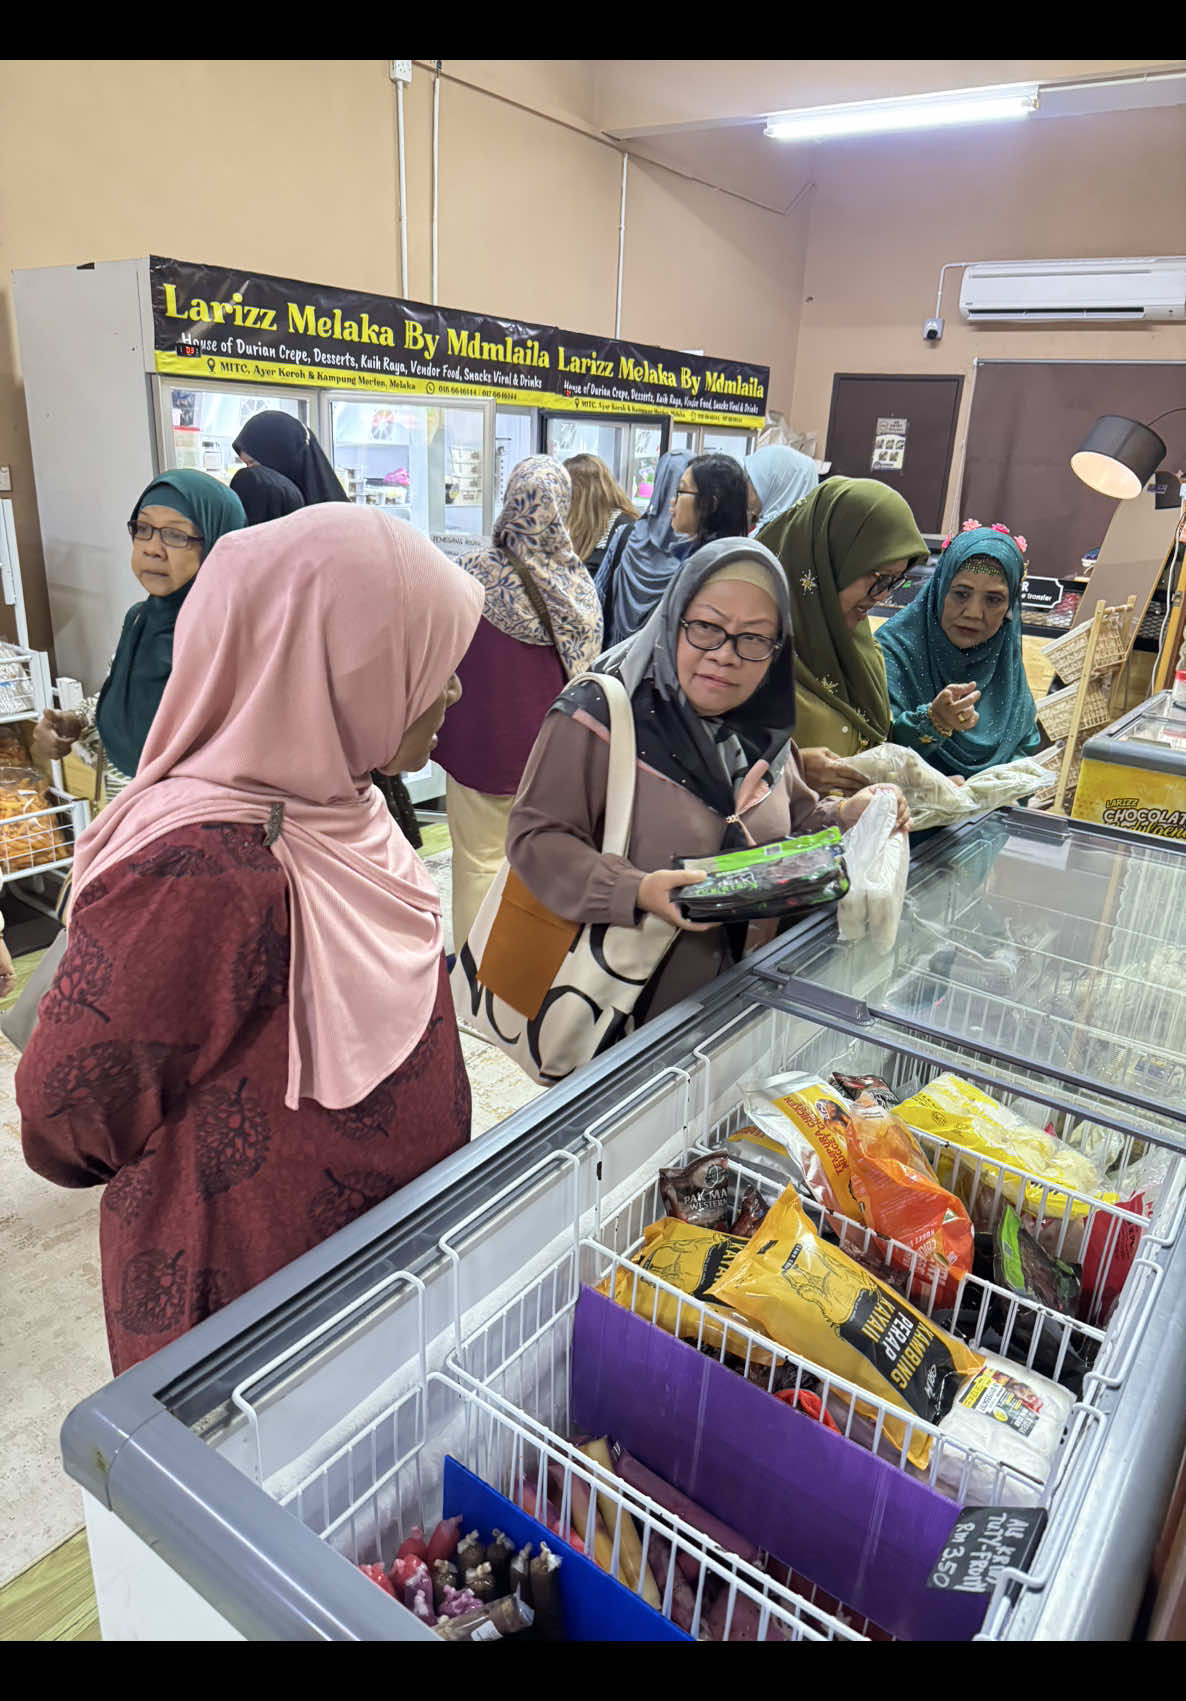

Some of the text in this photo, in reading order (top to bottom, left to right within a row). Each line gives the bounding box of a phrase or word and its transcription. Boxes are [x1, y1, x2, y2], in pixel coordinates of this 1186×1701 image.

[163, 283, 550, 369] Larizz Melaka By Mdmlaila
[182, 332, 542, 389] House of Durian Crepe, Desserts, Kuih Raya, Vendor Food, Snacks Viral & Drinks
[220, 362, 250, 374] MITC,
[253, 366, 276, 378] Ayer
[278, 369, 305, 380] Keroh
[308, 371, 314, 380] &
[317, 371, 356, 385] Kampung
[389, 380, 416, 391] Melaka
[557, 346, 764, 400] Larizz Melaka By Mdmlaila
[1027, 592, 1053, 602] transfer
[1103, 808, 1186, 826] CHOCOLAT
[1106, 799, 1139, 809] LARIZZ
[684, 1190, 706, 1206] PAK
[881, 1311, 914, 1362] PERAP
[890, 1321, 934, 1391] KAMBING
[933, 1545, 965, 1588] 3.50
